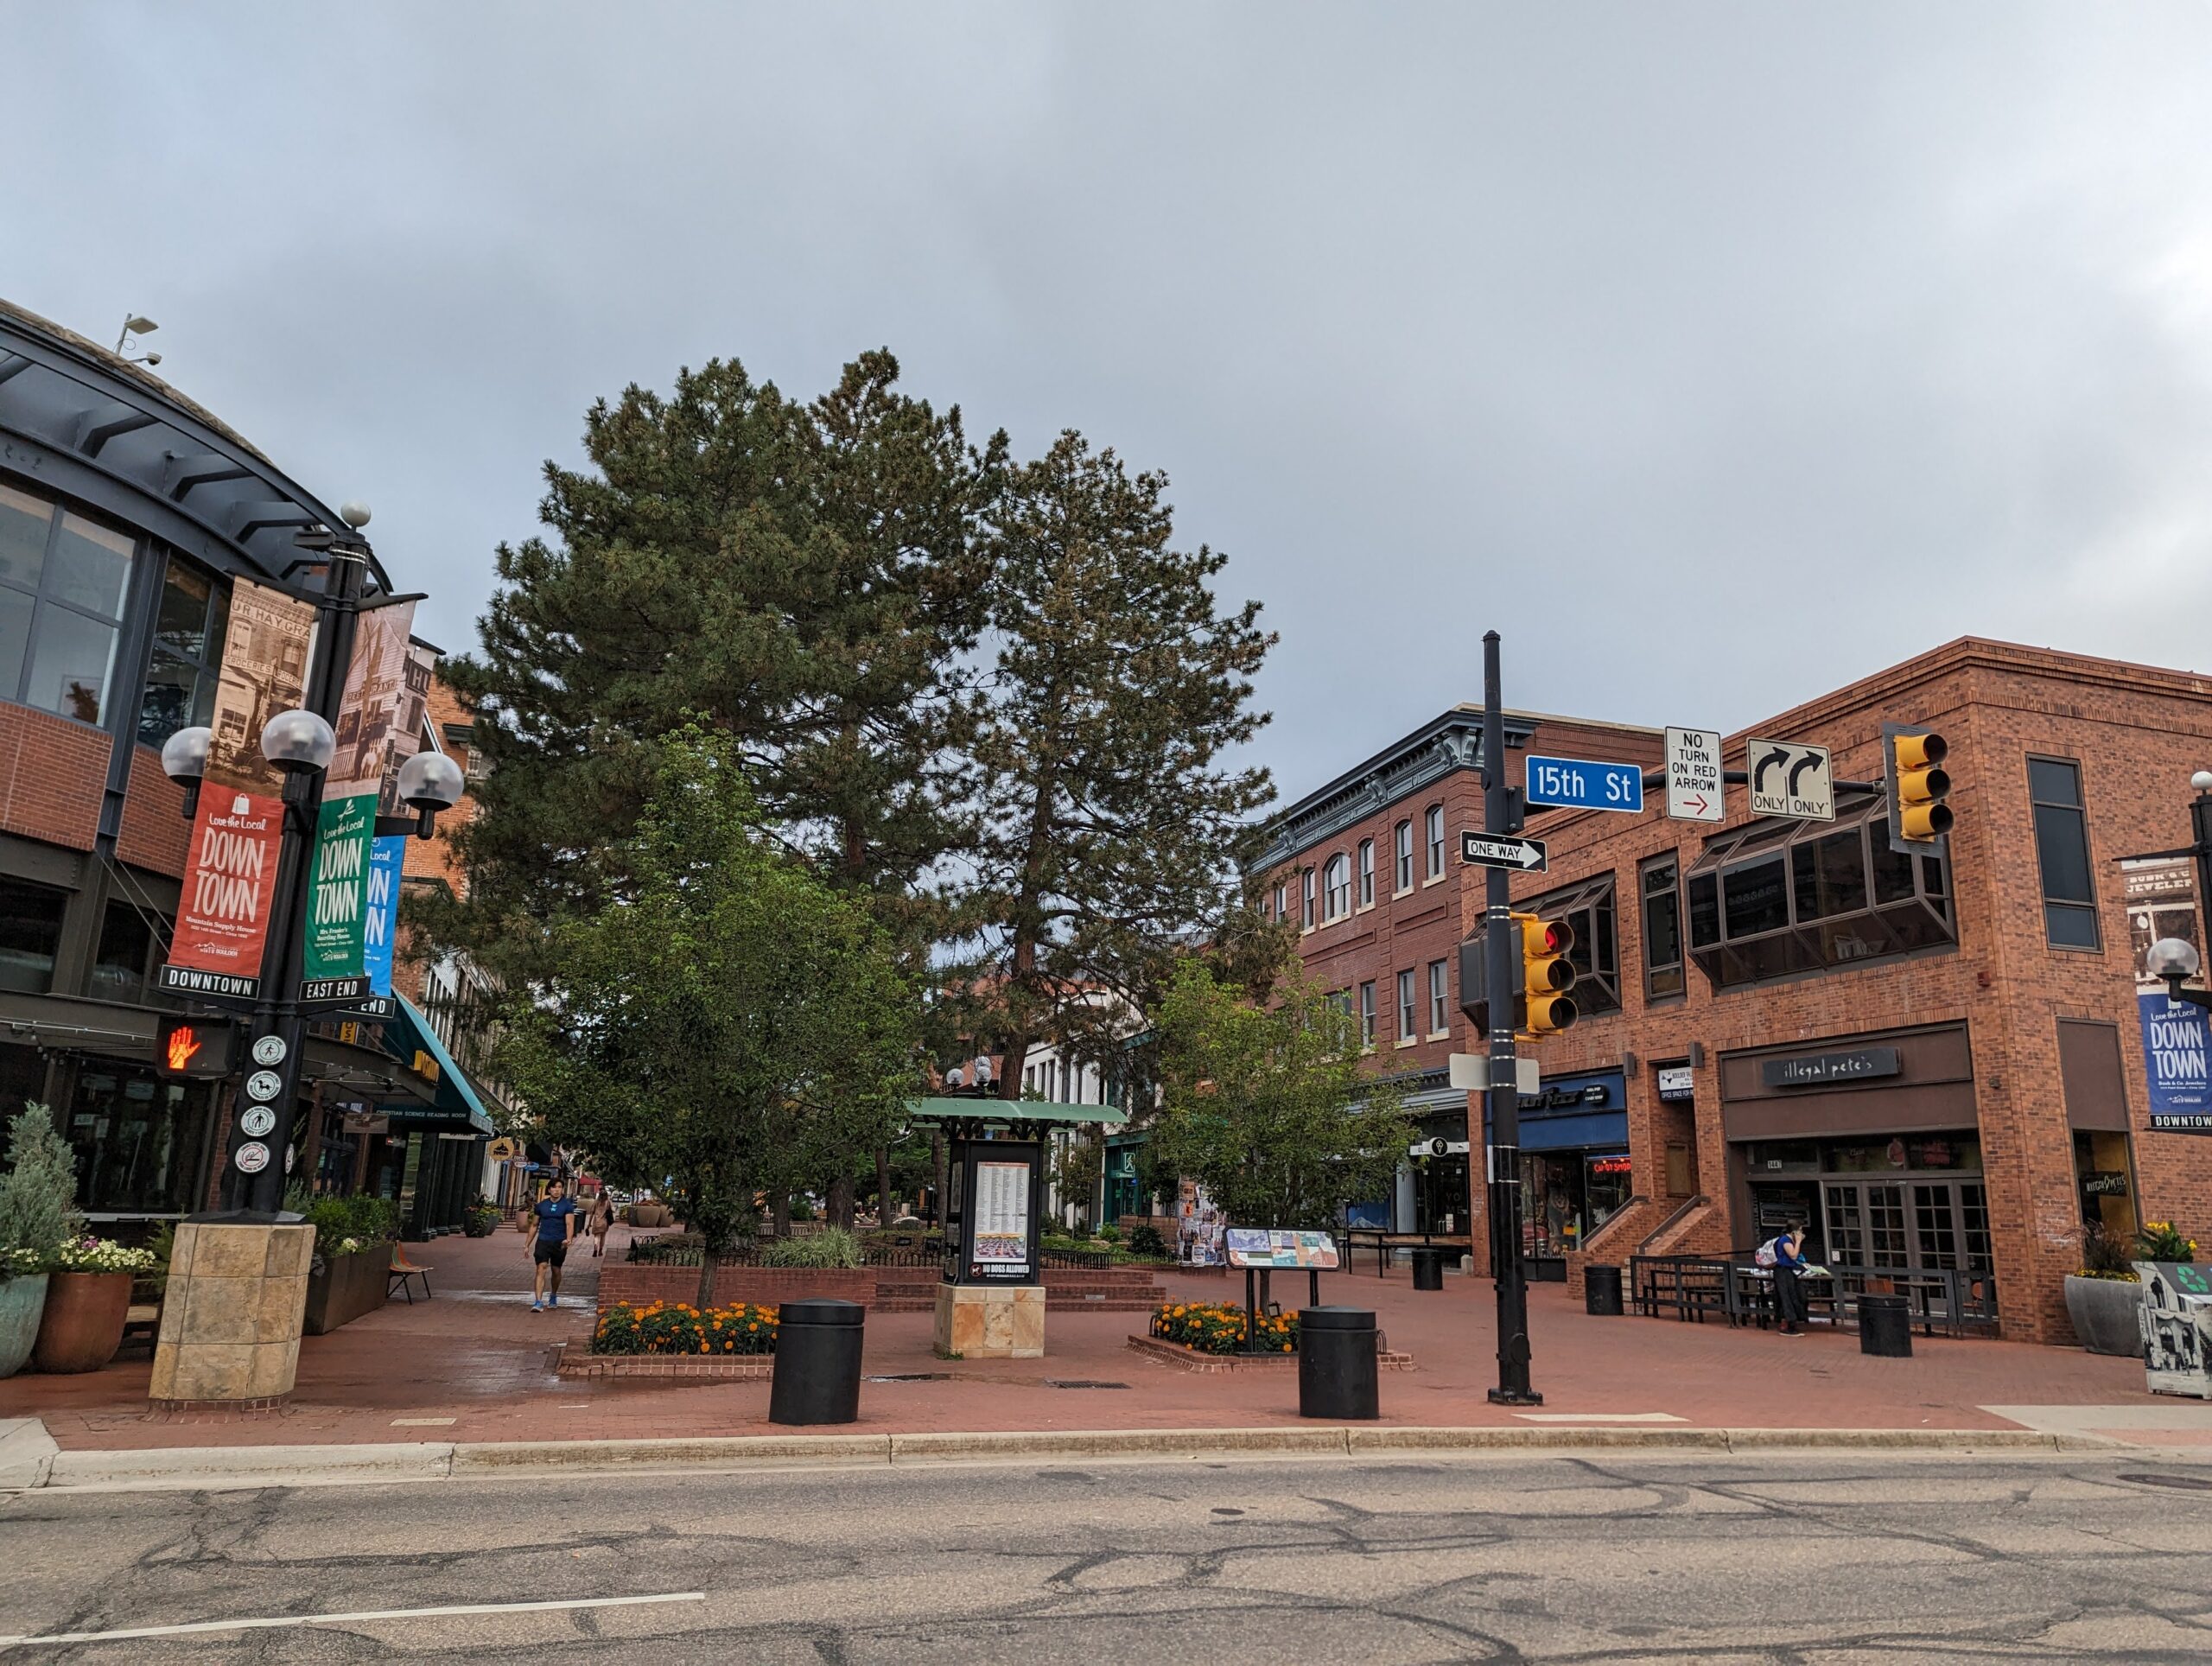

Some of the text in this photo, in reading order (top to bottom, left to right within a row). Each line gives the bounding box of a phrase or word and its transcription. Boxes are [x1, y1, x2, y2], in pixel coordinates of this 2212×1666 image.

[226, 657, 270, 673] GROCERIES
[1684, 733, 1702, 748] NO
[1679, 748, 1709, 763] TURN
[1672, 762, 1716, 778] ON RED
[1537, 766, 1631, 802] 15th St
[1675, 778, 1715, 792] ARROW
[1754, 796, 1785, 811] ONLY
[1794, 800, 1824, 814] ONLY
[209, 812, 267, 831] Love the Local
[323, 816, 365, 840] Love the Local
[199, 826, 266, 879] DOWN
[318, 836, 363, 881] DOWN
[370, 849, 391, 862] Local
[1471, 842, 1522, 860] ONE WAY
[193, 869, 260, 923] TOWN
[315, 880, 359, 925] TOWN
[185, 915, 257, 933] Mountain Supply House
[168, 970, 252, 995] DOWNTOWN
[306, 981, 358, 999] EAST END
[2151, 1007, 2197, 1021] Love the Local
[2150, 1021, 2203, 1049] DOWN
[1784, 1055, 1872, 1080] illegal pete's
[2152, 1050, 2207, 1079] TOWN
[982, 1264, 1030, 1274] NO DOGS ALLOWED
